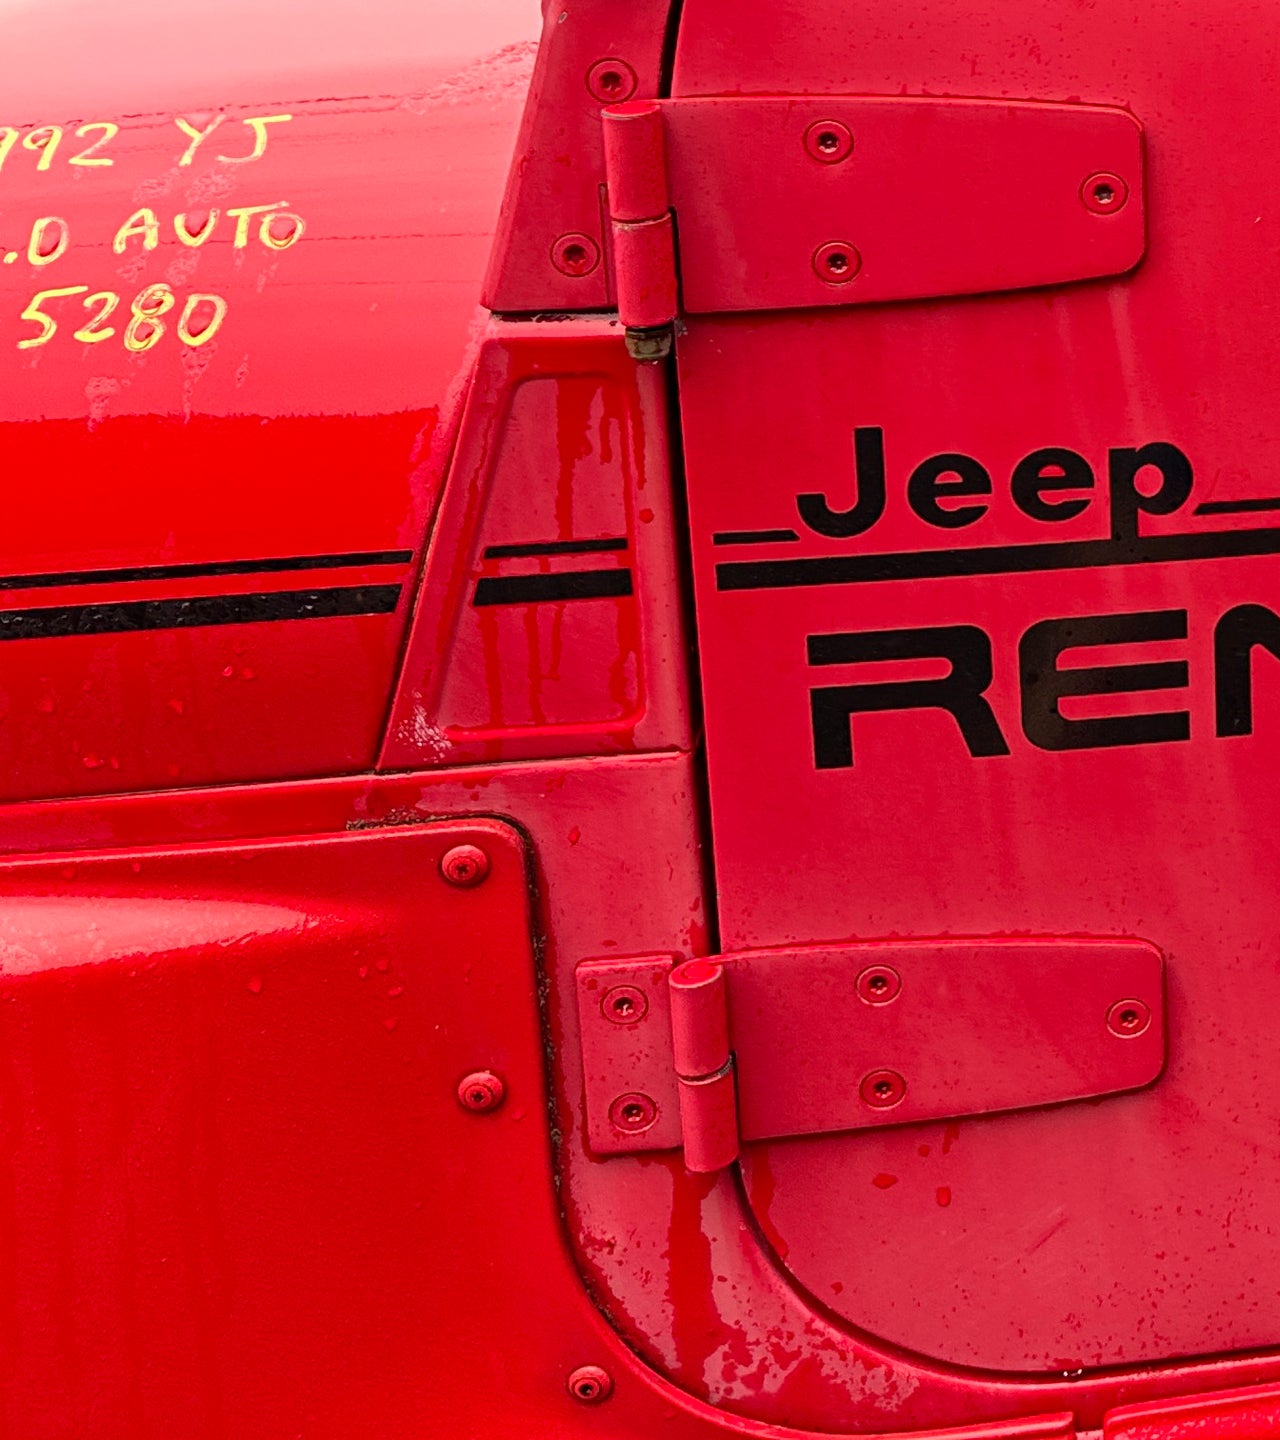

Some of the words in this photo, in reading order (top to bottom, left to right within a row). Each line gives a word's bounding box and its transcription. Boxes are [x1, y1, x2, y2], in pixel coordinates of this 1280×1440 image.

[174, 113, 293, 166] YJ
[113, 200, 306, 254] AUTO
[17, 283, 228, 352] 5280
[796, 426, 1194, 540] Jeep
